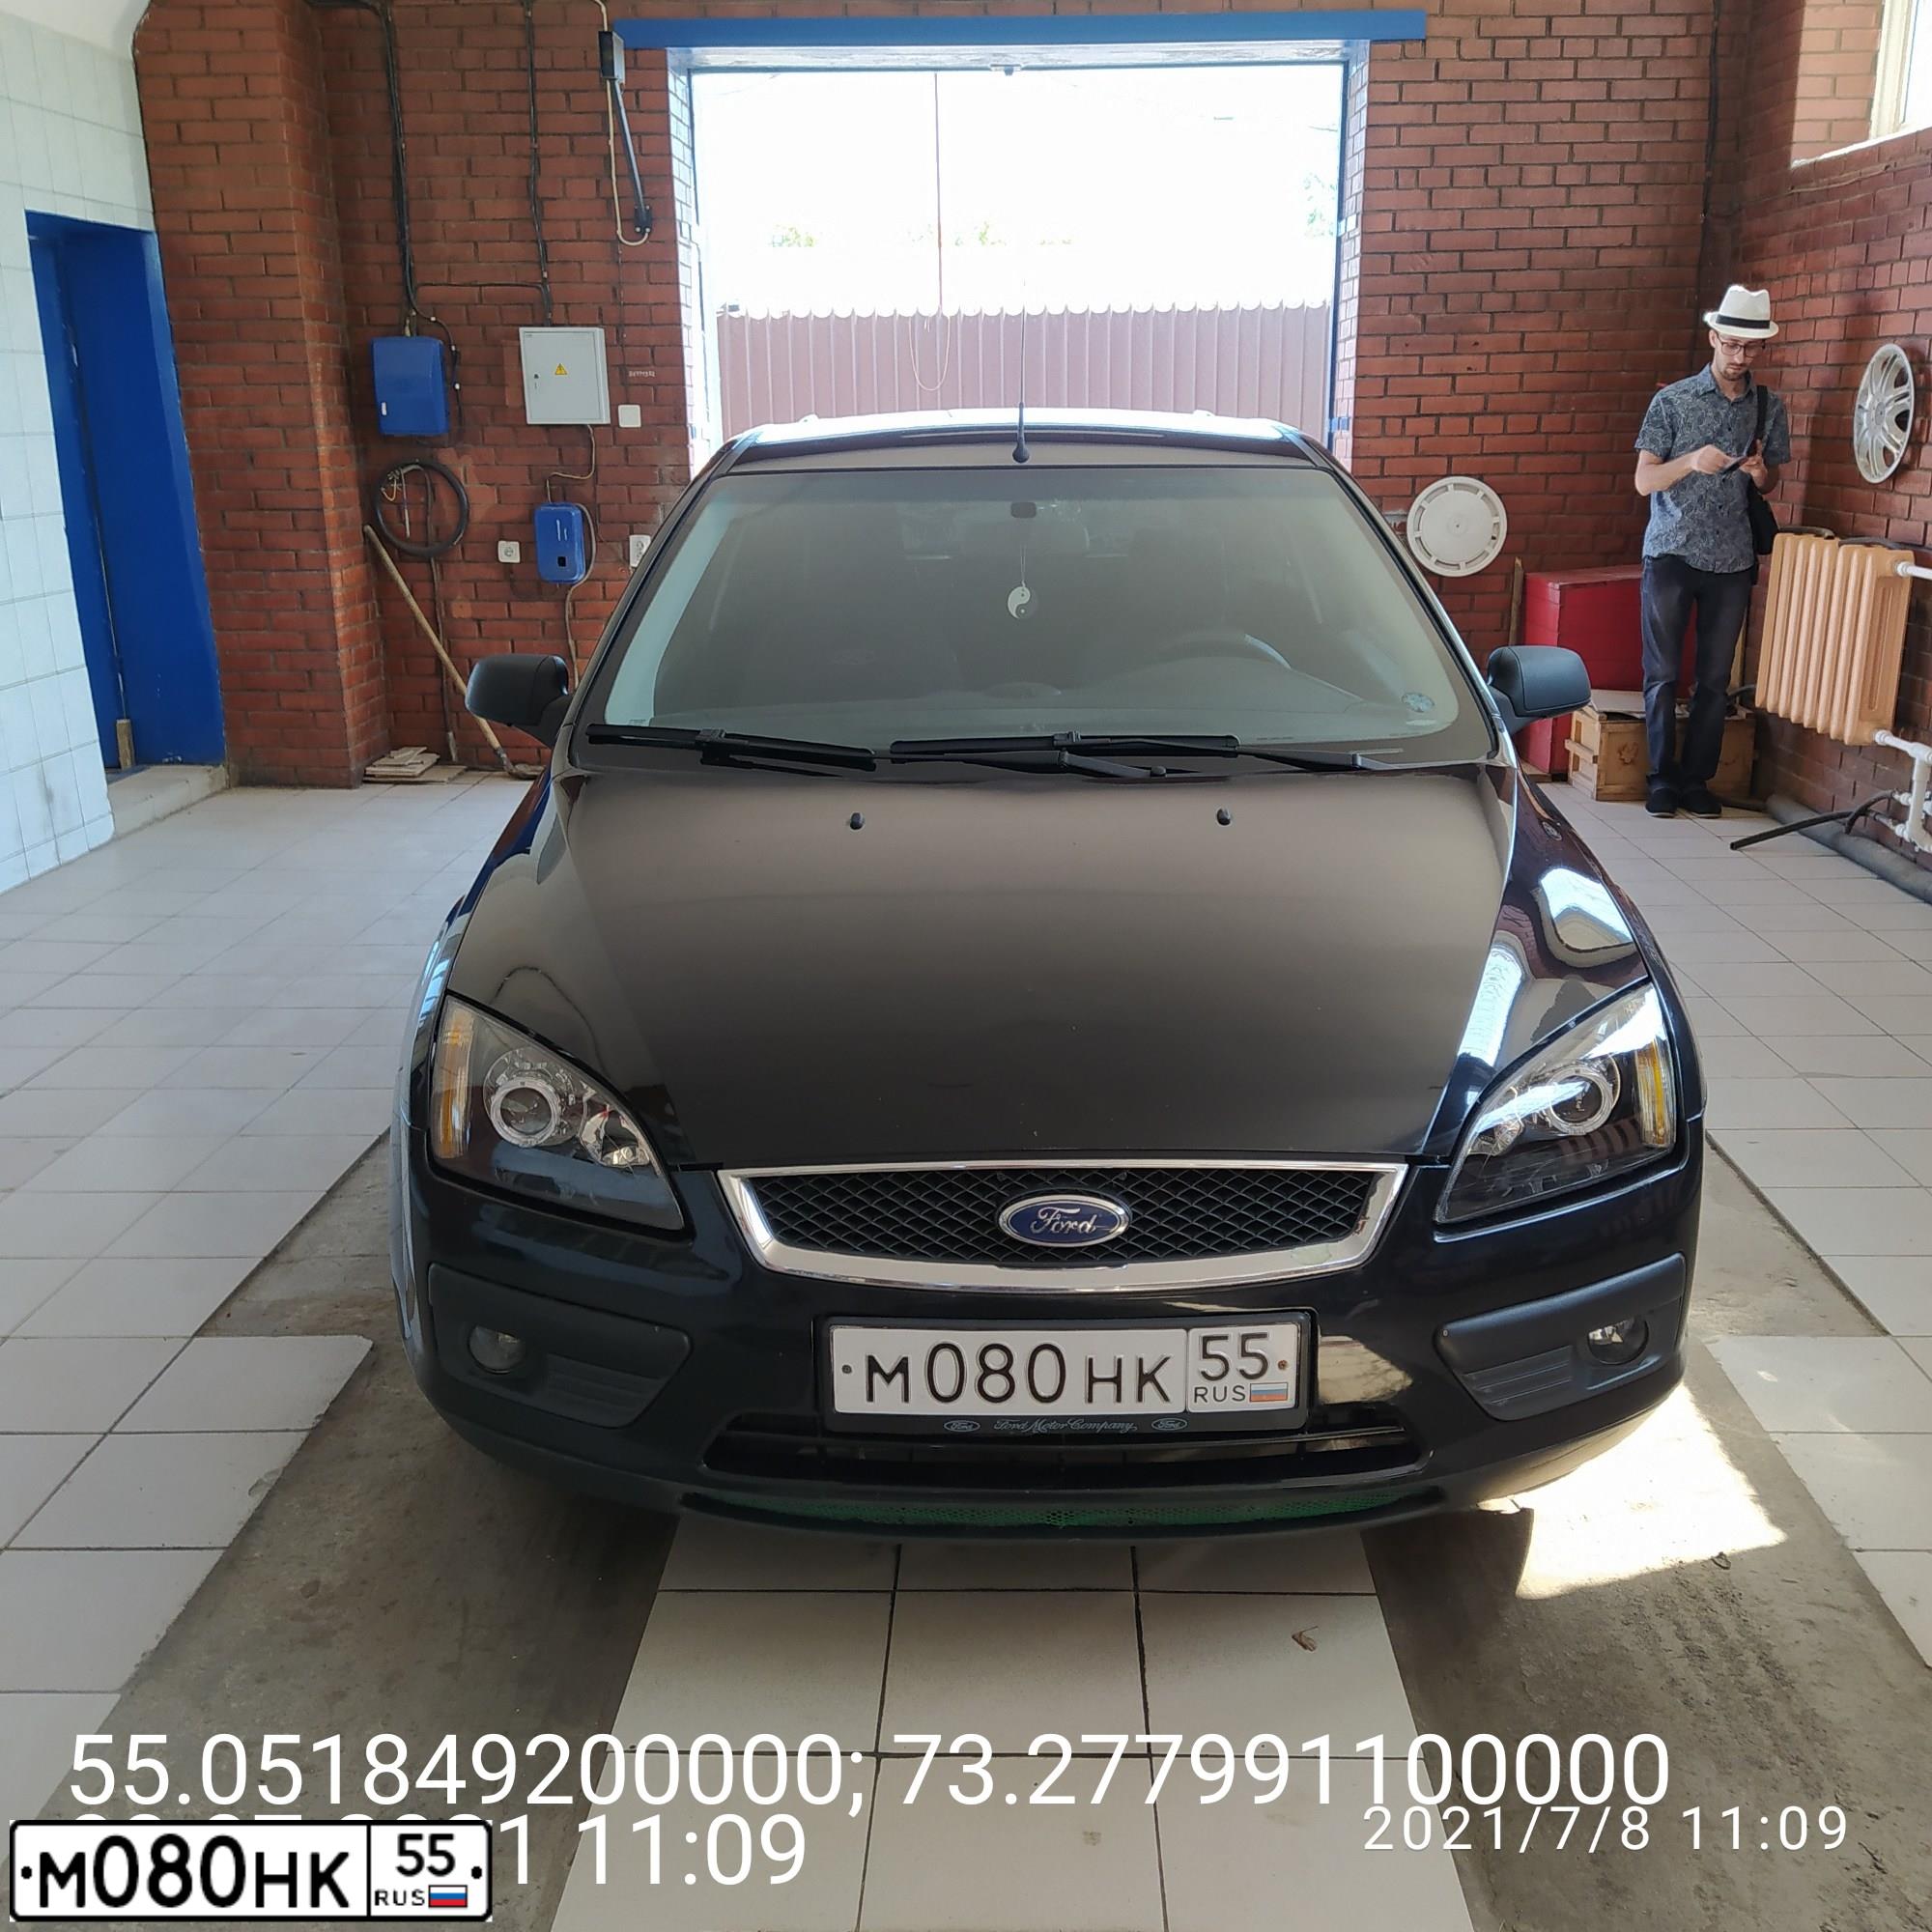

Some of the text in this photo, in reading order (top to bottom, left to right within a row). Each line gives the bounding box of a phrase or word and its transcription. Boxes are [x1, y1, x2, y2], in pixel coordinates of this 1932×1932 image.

[1030, 1206, 1097, 1235] Ford
[1198, 1332, 1269, 1381] 55
[1193, 1384, 1247, 1404] RUS
[993, 1417, 1138, 1434] Ford Motor Company
